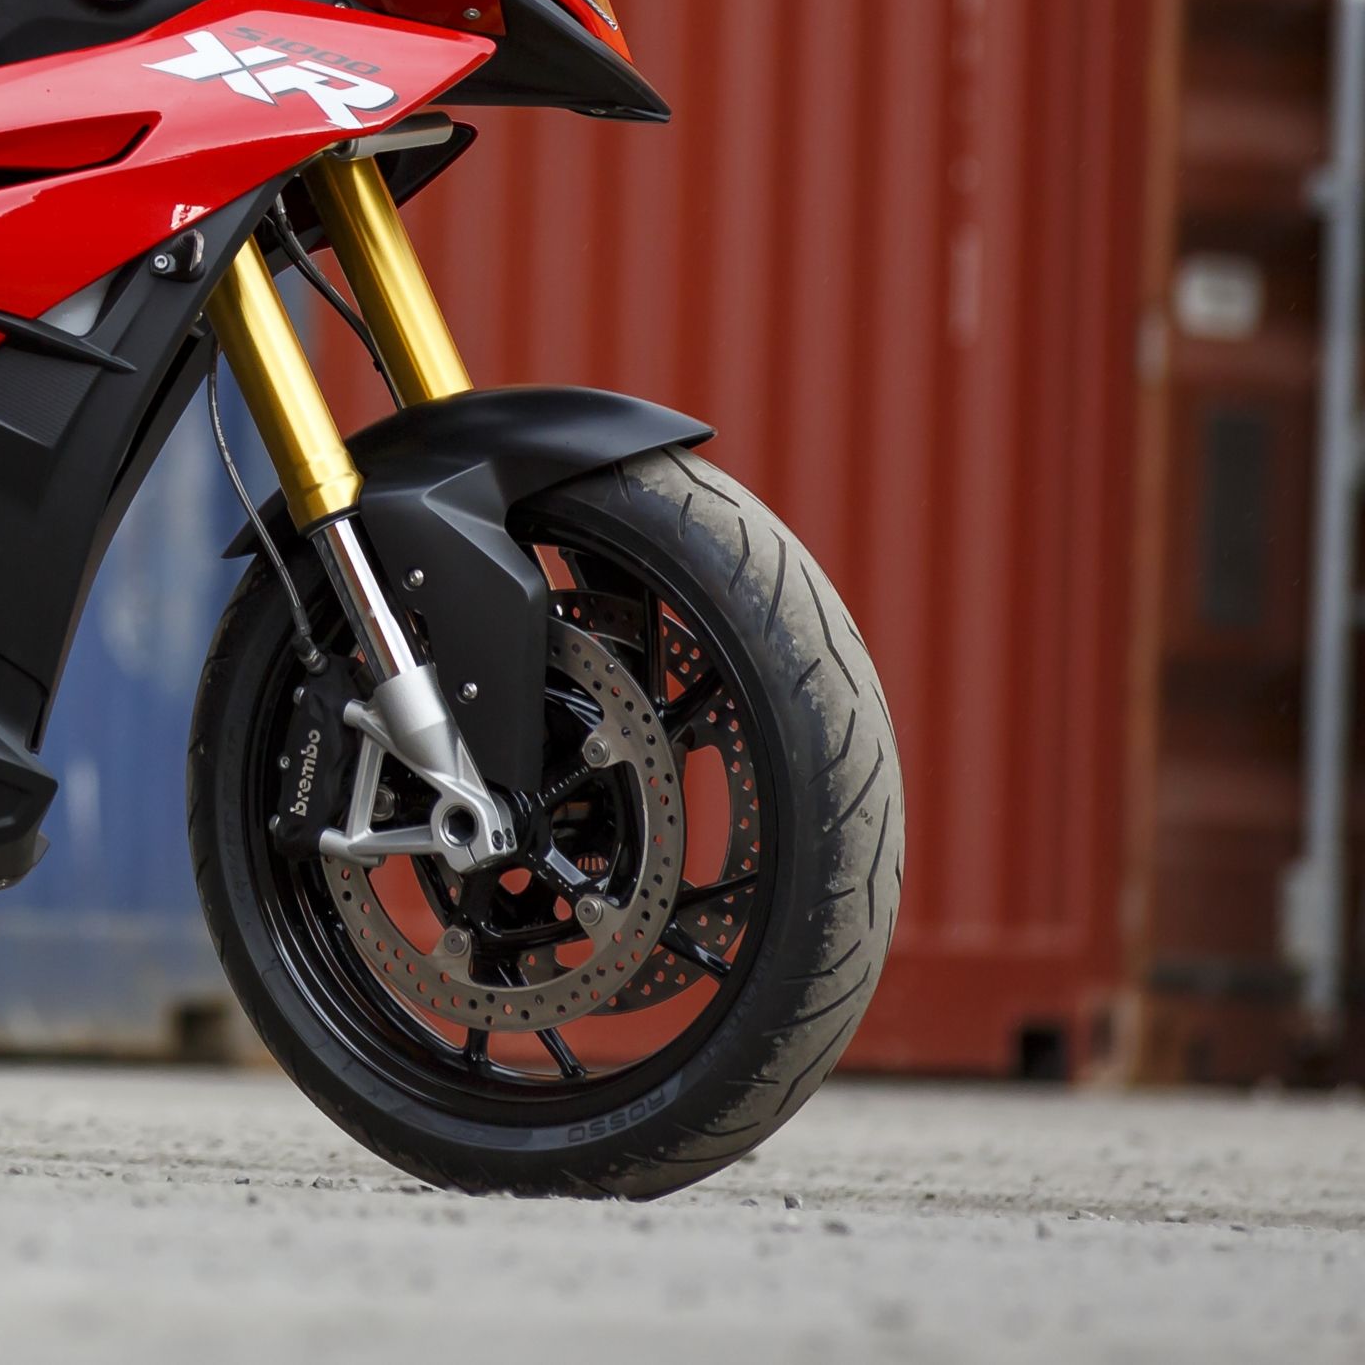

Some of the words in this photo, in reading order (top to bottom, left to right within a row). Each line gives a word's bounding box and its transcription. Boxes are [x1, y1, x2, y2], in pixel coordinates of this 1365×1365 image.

[141, 30, 400, 129] XR
[226, 27, 268, 42] S
[266, 37, 382, 75] 1000
[290, 729, 321, 817] brembo
[567, 1089, 666, 1144] ROSSO
